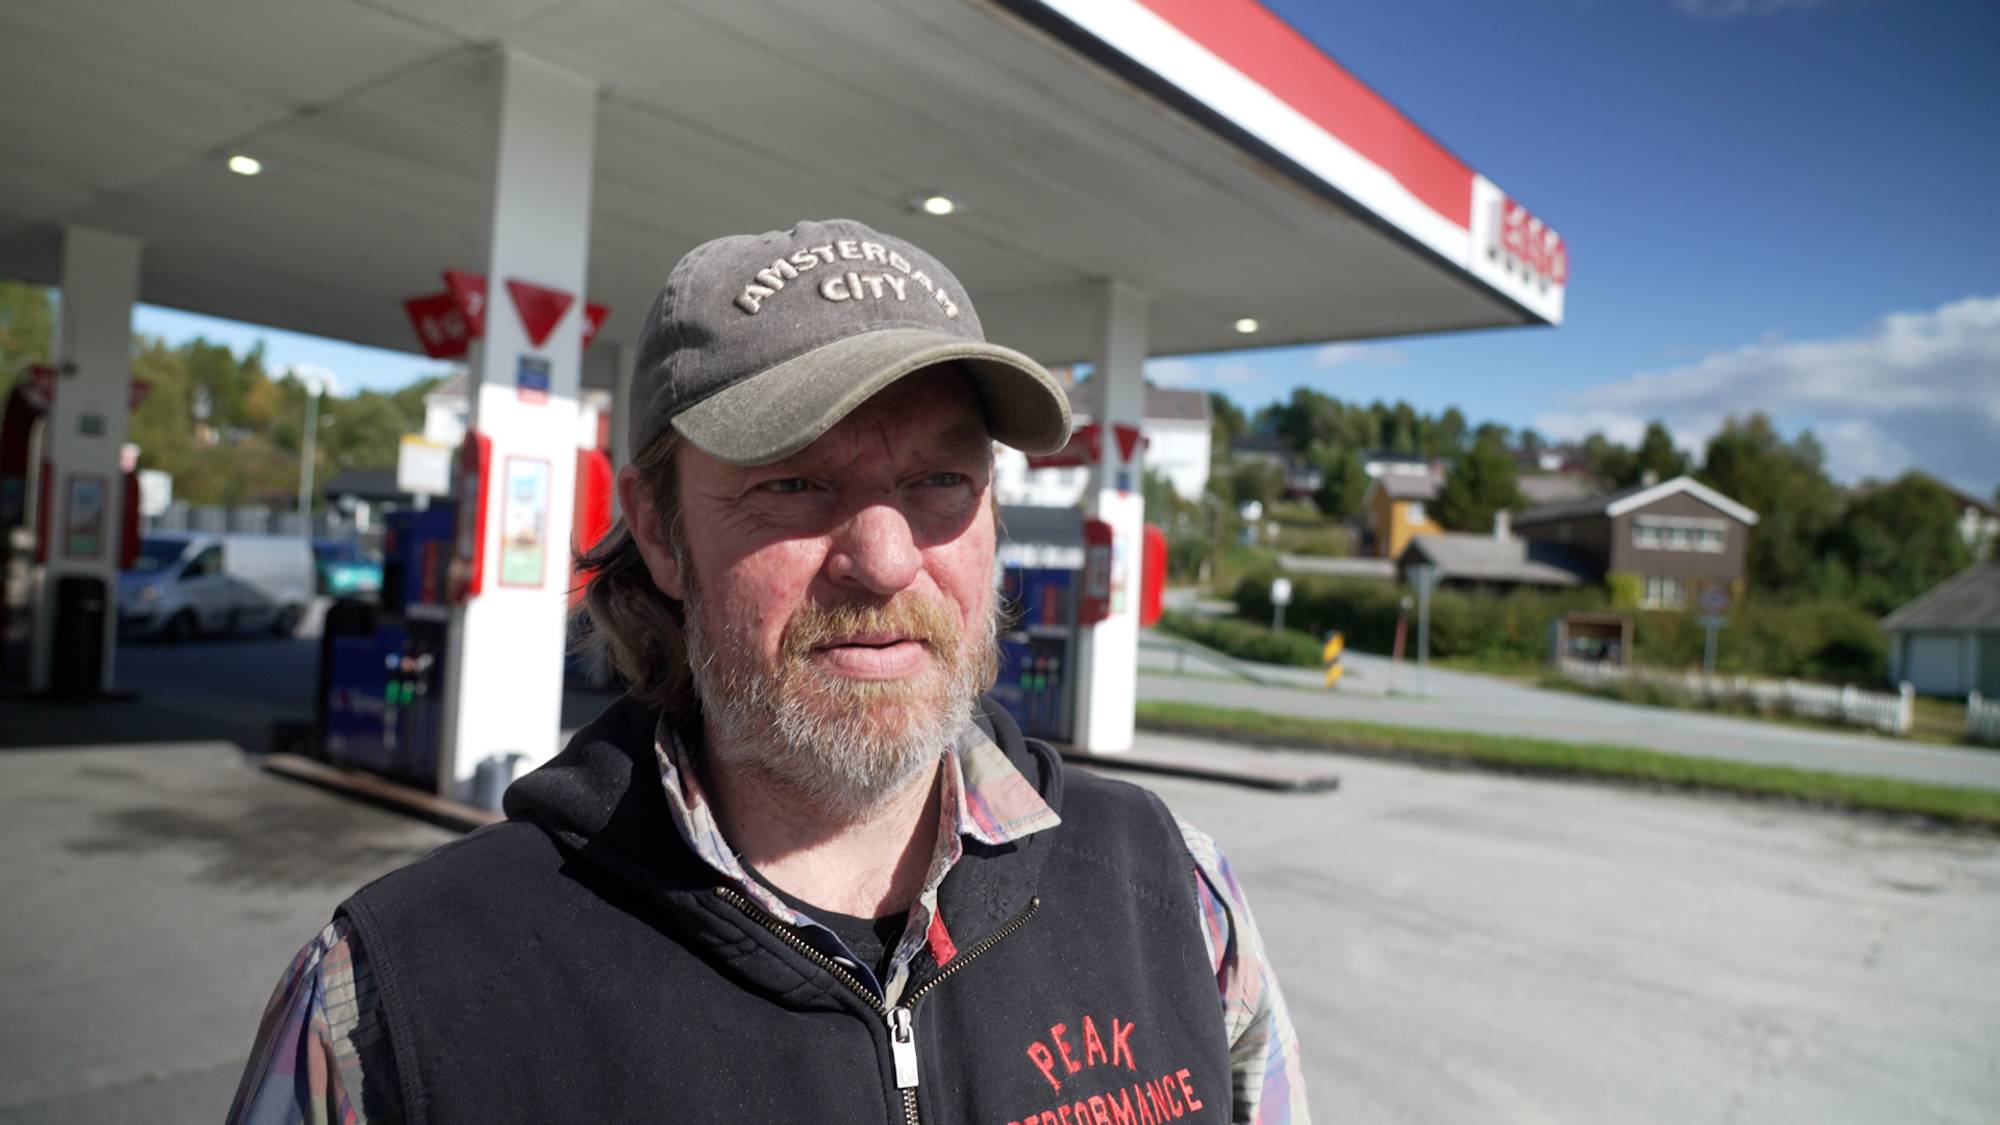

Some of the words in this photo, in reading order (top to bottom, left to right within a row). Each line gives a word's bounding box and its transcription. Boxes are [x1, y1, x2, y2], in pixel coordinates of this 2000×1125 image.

[736, 239, 959, 317] AMSTERDAM
[820, 272, 905, 301] CITY
[1027, 1015, 1137, 1095] PEAK
[1007, 1068, 1204, 1125] FORMANCE
